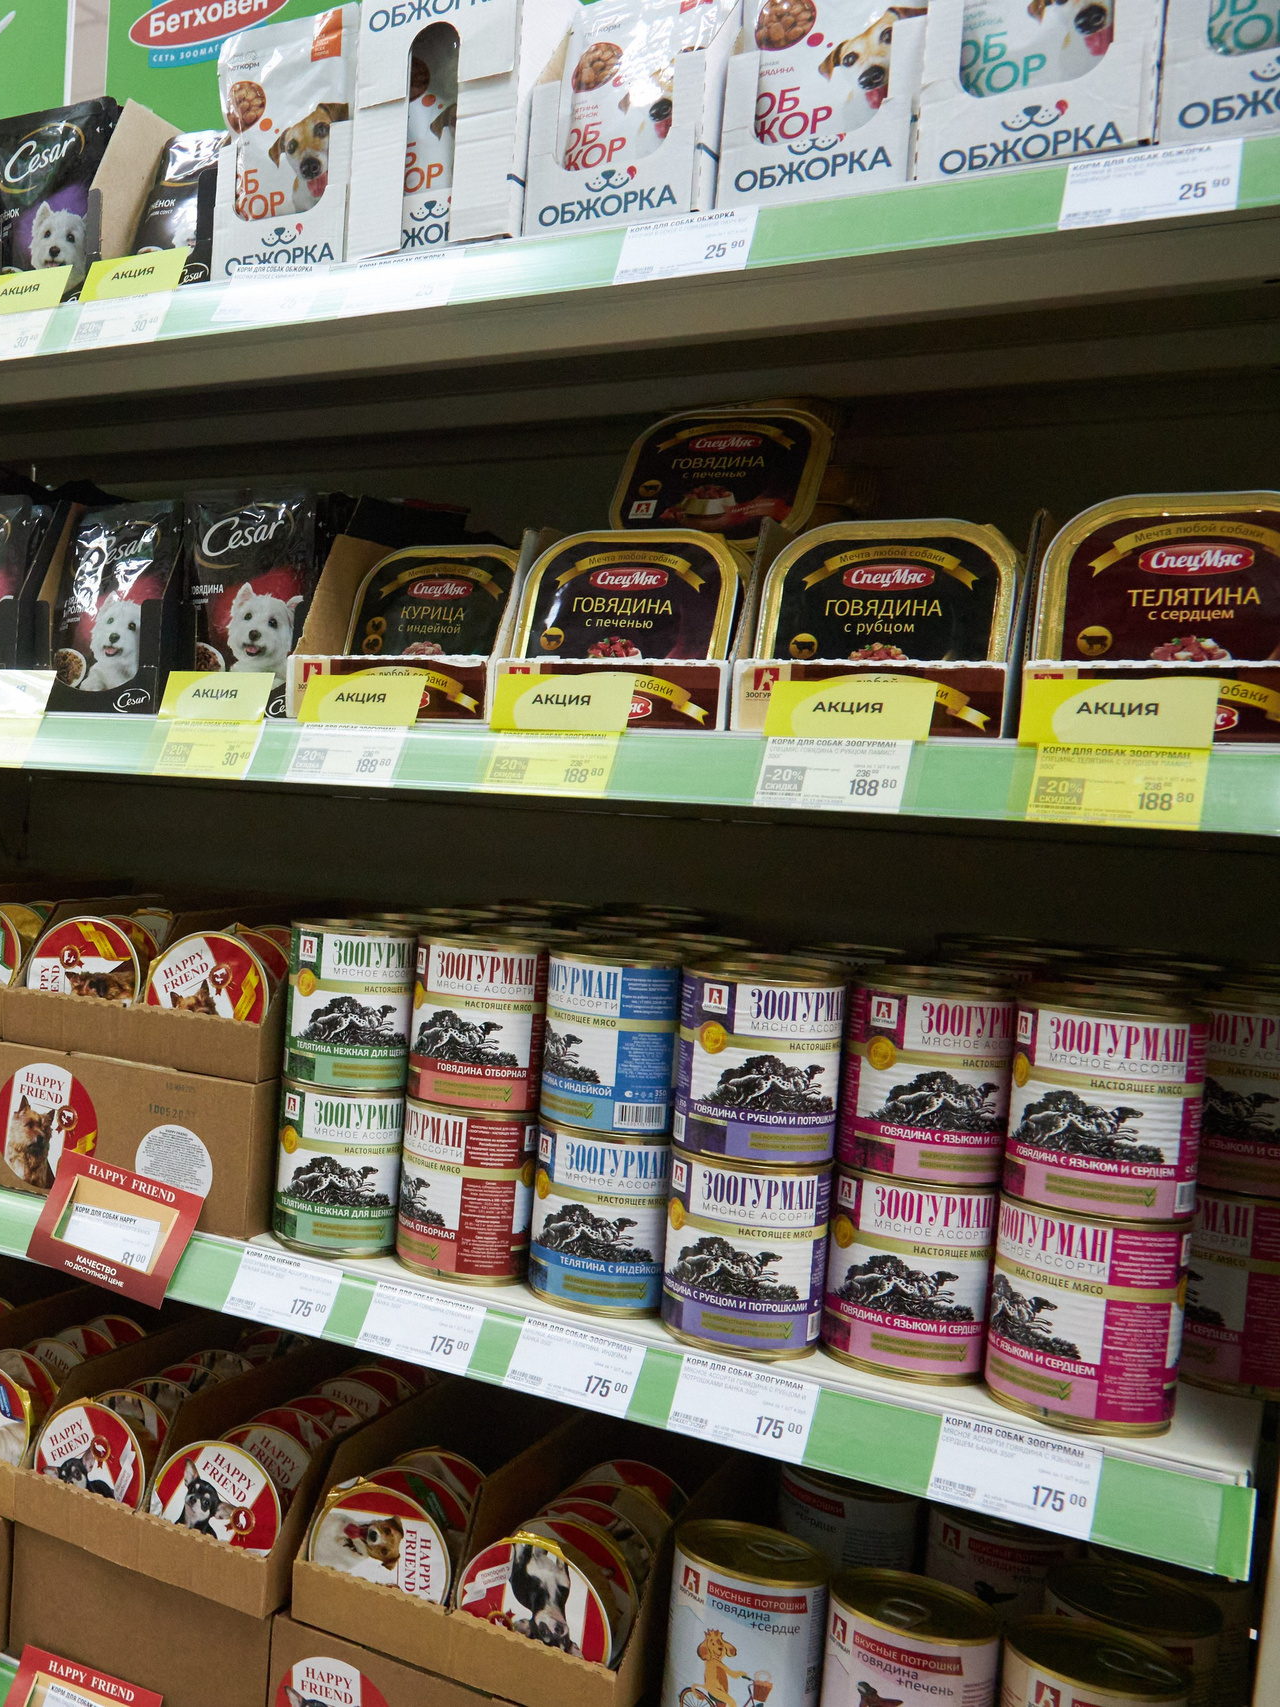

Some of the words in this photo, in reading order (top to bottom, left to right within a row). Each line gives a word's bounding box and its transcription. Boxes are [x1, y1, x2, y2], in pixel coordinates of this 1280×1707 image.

[152, 52, 175, 62] СЕТЬ
[939, 122, 1123, 174] ОБЖОРКА
[4, 136, 76, 183] Cesar
[734, 146, 892, 193] ОБЖОРКА
[1179, 182, 1207, 201] 25
[1212, 177, 1230, 188] 90
[539, 185, 677, 227] ОБЖОРКА
[630, 225, 650, 234] КОРМ
[653, 222, 668, 231] ДЛЯ
[670, 218, 694, 228] СОБАК
[697, 211, 735, 223] ОБЖОРКА
[704, 243, 727, 260] 25
[731, 239, 745, 249] 90
[111, 266, 155, 281] АКЦИЯ
[0, 283, 40, 297] АКЦИЯ
[695, 436, 755, 449] СпецМяс
[672, 456, 765, 470] ГОВЯДИНА
[693, 471, 746, 479] печенью
[201, 516, 285, 557] Cesar
[839, 551, 870, 563] Мечта
[873, 548, 907, 558] любой
[909, 550, 946, 563] собаки
[1150, 550, 1243, 573] СпецМяс
[596, 571, 661, 588] СпецМяс
[851, 569, 926, 587] СпецМяс
[413, 582, 467, 598] СпецМяс
[1127, 587, 1261, 607] ТЕЛЯТИНА
[401, 606, 465, 622] КУРИЦА
[572, 597, 673, 615] ГОВЯДИНА
[824, 600, 942, 619] ГОВЯДИНА
[1148, 610, 1157, 620] с
[1161, 608, 1234, 622] сердцем
[406, 623, 461, 634] индейкой
[585, 618, 592, 627] с
[596, 618, 653, 629] печенью
[844, 623, 852, 632] с
[857, 621, 915, 635] рубцом
[192, 688, 238, 700] АКЦИЯ
[335, 692, 387, 704] АКЦИЯ
[532, 694, 591, 707] АКЦИЯ
[812, 702, 883, 715] АКЦИЯ
[1076, 701, 1159, 717] АКЦИЯ
[771, 738, 795, 746] КОРМ
[797, 739, 814, 747] ДЛЯ
[845, 740, 897, 748] ЗООГУРМАН
[222, 752, 238, 766] 30
[766, 769, 804, 781] -20%
[765, 782, 798, 790] СКИДКА
[849, 779, 879, 796] 188
[881, 779, 897, 789] 80
[1137, 792, 1173, 811] 188
[1176, 792, 1194, 803] 80
[162, 951, 205, 980] HAPPY
[437, 951, 534, 985] ЗООГУРМАН
[163, 962, 209, 993] FRIEND
[437, 980, 479, 992] МЯСНОЕ
[484, 985, 534, 996] АССОРТИ
[464, 1001, 512, 1011] НАСТОЯЩЕЕ
[513, 1004, 532, 1012] МЯСО
[296, 1040, 332, 1054] ТЕЛЯТИНА
[333, 1047, 369, 1057] НЕЖНАЯ
[371, 1049, 387, 1057] ДЛЯ
[1049, 1016, 1186, 1064] ЗООГУРМАН
[437, 1062, 483, 1076] ГОВЯДИНА
[485, 1068, 527, 1078] ОТБОРНАЯ
[25, 1072, 65, 1091] HAPPY
[558, 1080, 563, 1089] С
[564, 1080, 612, 1097] ИНДЕЙКОЙ
[20, 1083, 63, 1105] FRIEND
[1016, 1144, 1058, 1165] ГОВЯДИНА
[1060, 1155, 1067, 1166] С
[1069, 1156, 1118, 1174] ЯЗЫКОМ
[1121, 1163, 1130, 1175] И
[1132, 1166, 1175, 1180] СЕРДЦЕМ
[89, 1164, 127, 1185] HAPPY
[131, 1179, 175, 1203] FRIEND
[702, 1170, 815, 1211] ЗООГУРМАН
[75, 1205, 90, 1215] КОРМ
[90, 1209, 102, 1218] ДЛЯ
[102, 1211, 119, 1222] СОБАК
[120, 1215, 137, 1225] HAPPY
[76, 1255, 117, 1277] КАЧЕСТВО
[120, 1251, 134, 1266] 81
[136, 1253, 146, 1264] 00
[73, 1262, 108, 1282] ДОСТУПНОЙ
[108, 1276, 124, 1288] ЦЕНЕ
[699, 1290, 737, 1308] РУБЦОМ
[739, 1300, 746, 1309] И
[748, 1300, 807, 1312] ПОТРОШКАМИ
[585, 1374, 611, 1398] 175
[614, 1381, 628, 1394] 00
[945, 1416, 972, 1429] КОРМ
[973, 1423, 993, 1435] ДЛЯ
[995, 1429, 1025, 1444] СОБАК
[1027, 1437, 1085, 1458] ЗООГУРМАН
[1032, 1485, 1066, 1512] 175
[1069, 1494, 1087, 1508] 00
[404, 1529, 418, 1593] FRIEND
[420, 1537, 432, 1596] HAPPY
[708, 1585, 752, 1606] ВКУСНЫЕ
[754, 1595, 807, 1612] ПОТРОШКИ
[711, 1600, 772, 1622] говядина
[749, 1619, 801, 1636] +сердце
[896, 1676, 954, 1698] +печень
